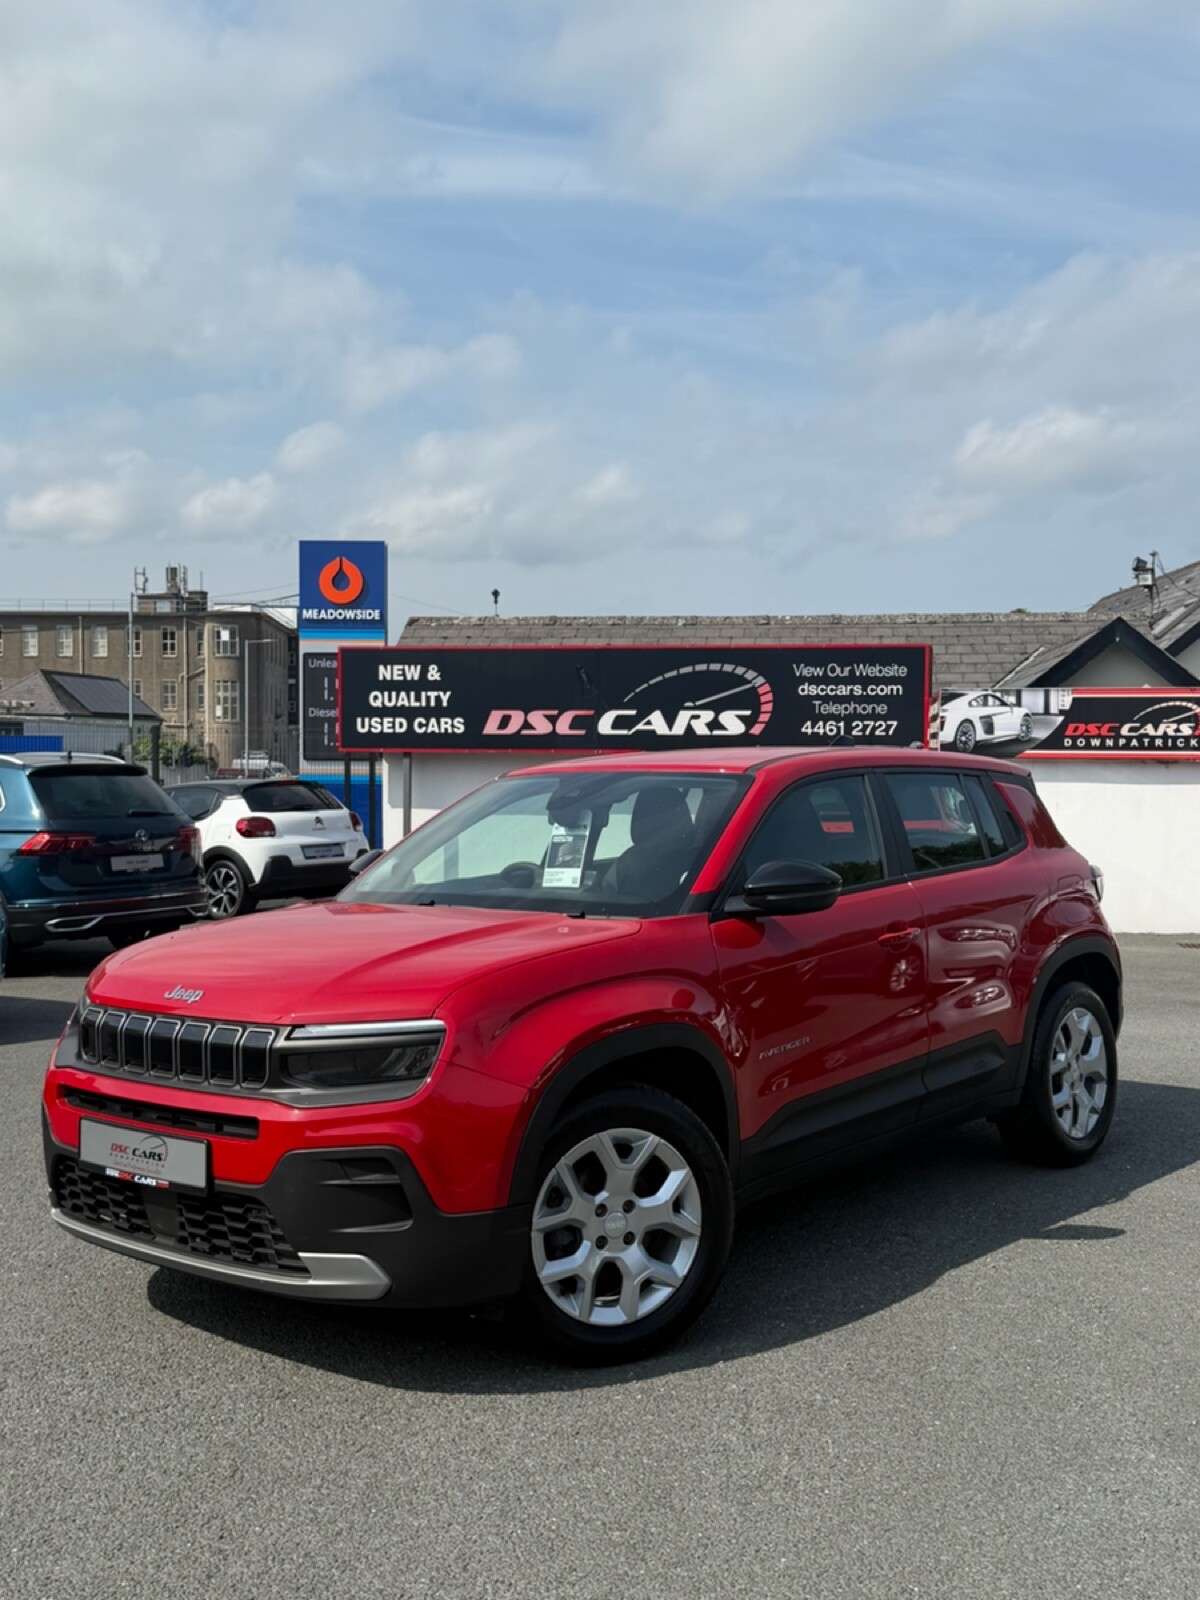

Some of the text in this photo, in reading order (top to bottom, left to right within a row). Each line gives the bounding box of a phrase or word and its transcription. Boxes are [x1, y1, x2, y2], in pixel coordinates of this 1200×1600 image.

[302, 608, 381, 621] MEADOWSIDE
[308, 658, 338, 669] Unlea
[793, 664, 907, 677] View Our Website
[378, 664, 441, 681] NEW &
[798, 682, 903, 696] dsccars.com
[368, 691, 451, 708] QUALITY
[308, 707, 339, 718] Diese
[812, 700, 888, 717] Telephone
[356, 717, 465, 734] USED CARS
[482, 709, 752, 736] DSC CARS
[800, 721, 898, 736] 4461 2727
[1064, 723, 1196, 736] DSC CARS
[1064, 738, 1199, 747] DOWNPATRICK
[164, 984, 204, 1004] Jeep
[132, 1147, 164, 1162] CARS
